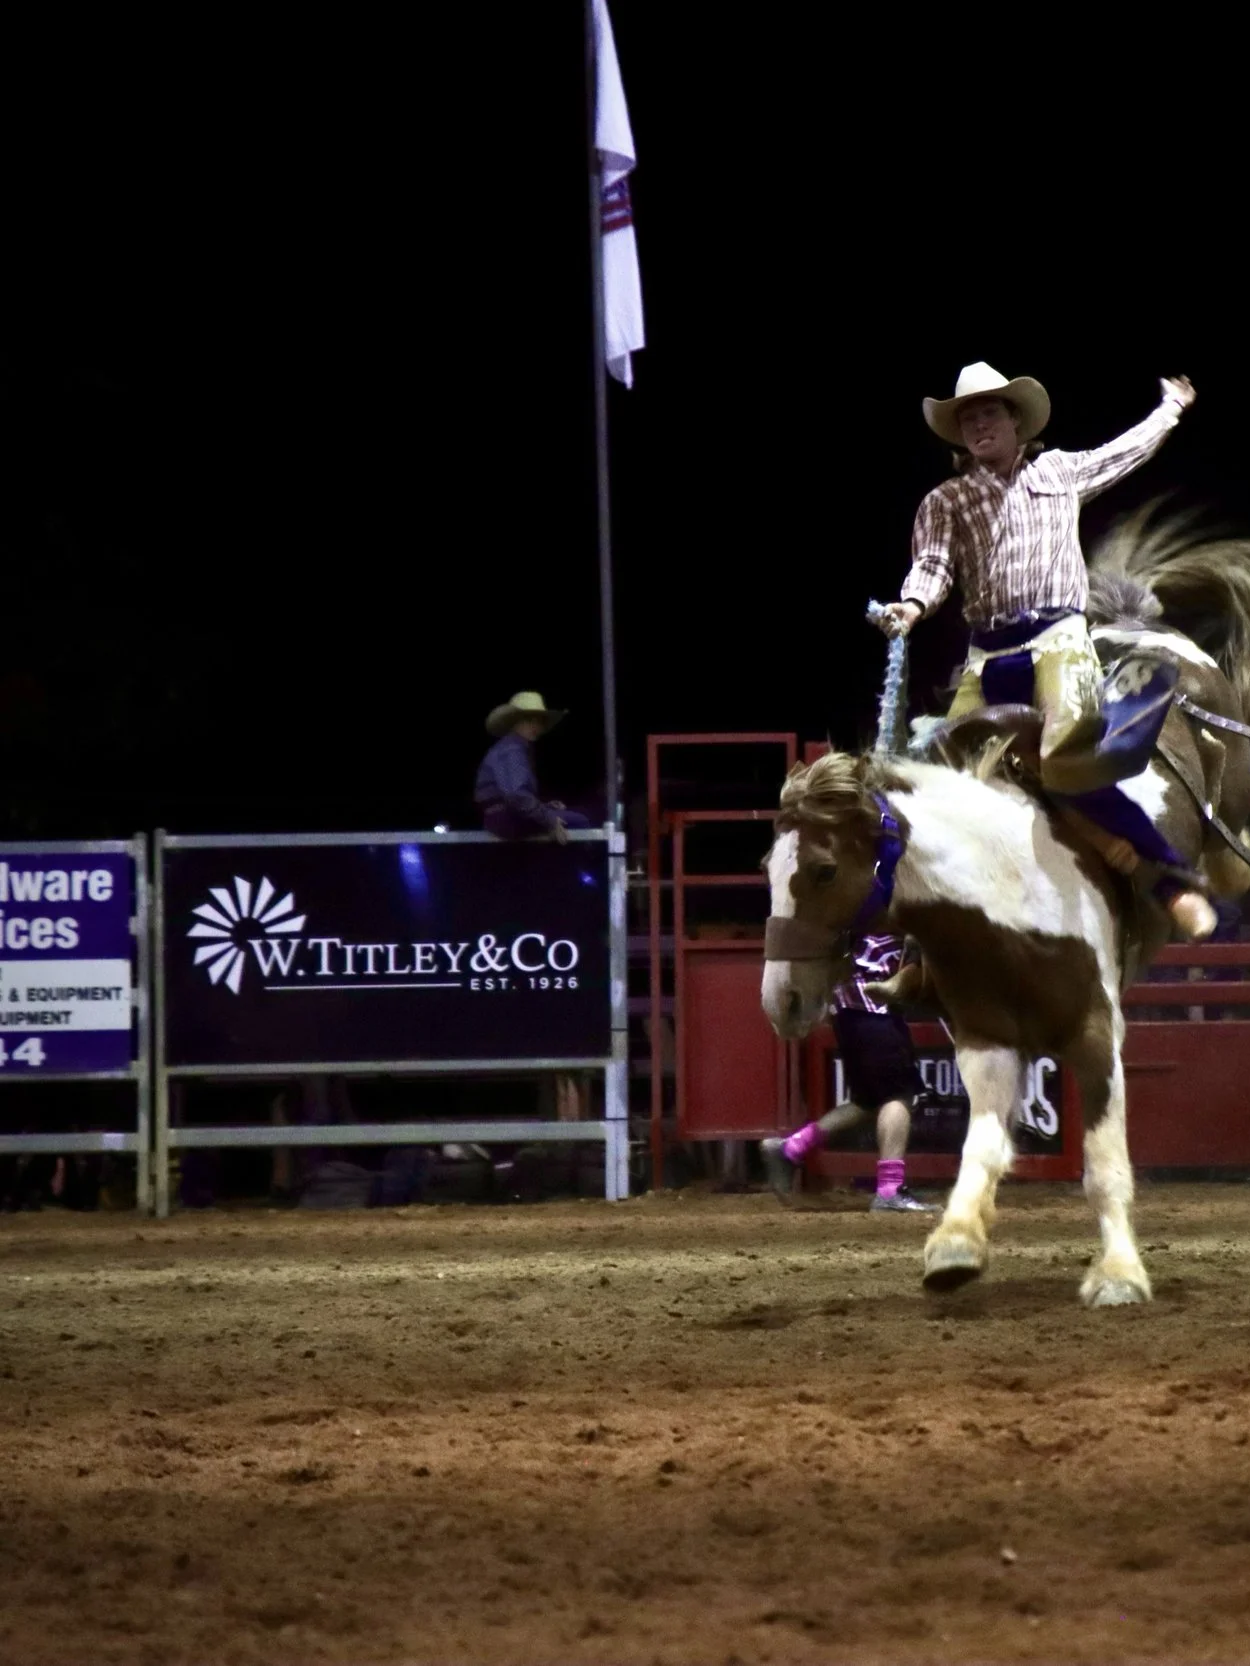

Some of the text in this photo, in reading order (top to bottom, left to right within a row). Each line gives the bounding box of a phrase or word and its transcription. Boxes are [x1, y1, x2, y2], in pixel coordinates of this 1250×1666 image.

[470, 976, 579, 991] EST. 1926
[26, 986, 123, 1002] EQUIPMENT
[0, 1037, 46, 1066] 4
